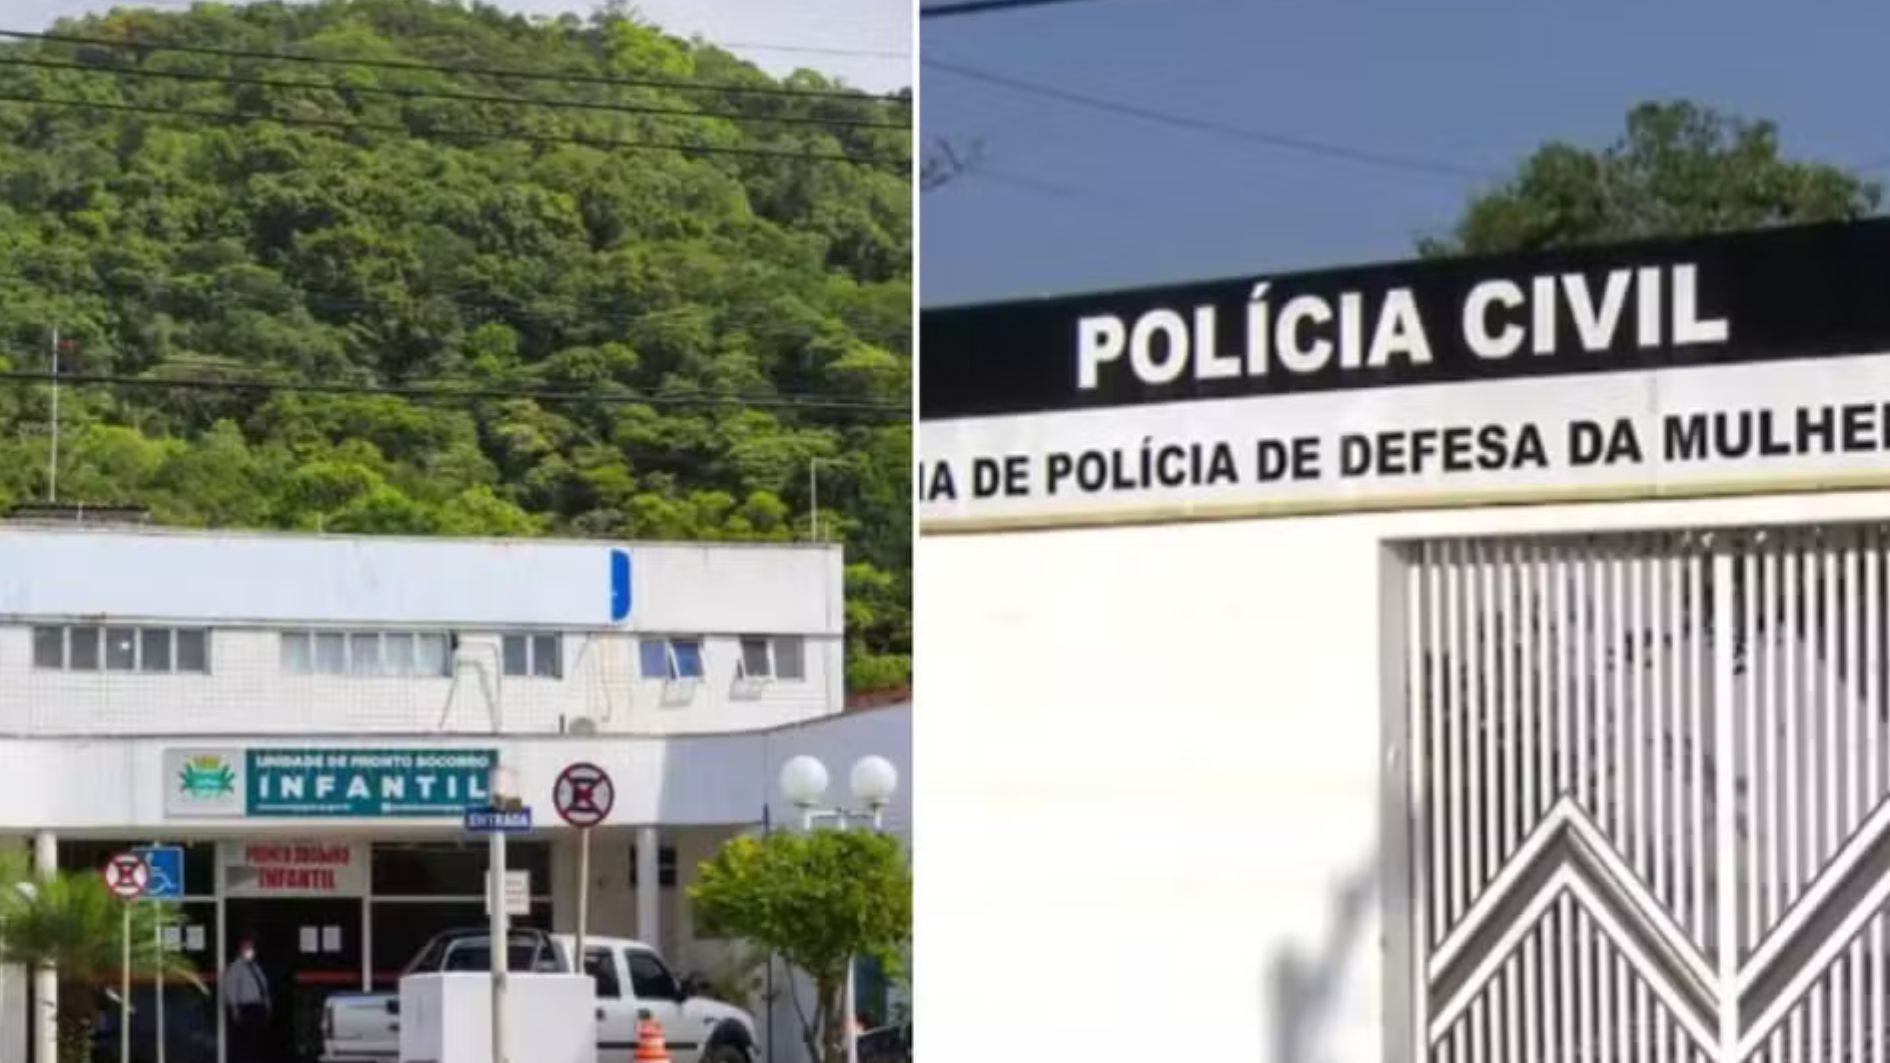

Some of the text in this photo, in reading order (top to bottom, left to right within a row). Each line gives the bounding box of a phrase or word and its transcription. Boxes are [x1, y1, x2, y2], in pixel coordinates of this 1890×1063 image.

[1078, 264, 1729, 389] POLÍCIA CIVIL
[973, 456, 1029, 498] DE
[1047, 436, 1239, 495] POLÍCIA
[1257, 437, 1321, 482] DE
[1340, 423, 1548, 477] DEFESA
[1569, 418, 1642, 466] DA
[1664, 402, 1890, 461] MULHE
[259, 774, 488, 799] INFANTIL
[469, 812, 530, 829] ENTRADA
[258, 867, 335, 890] INFANTIL
